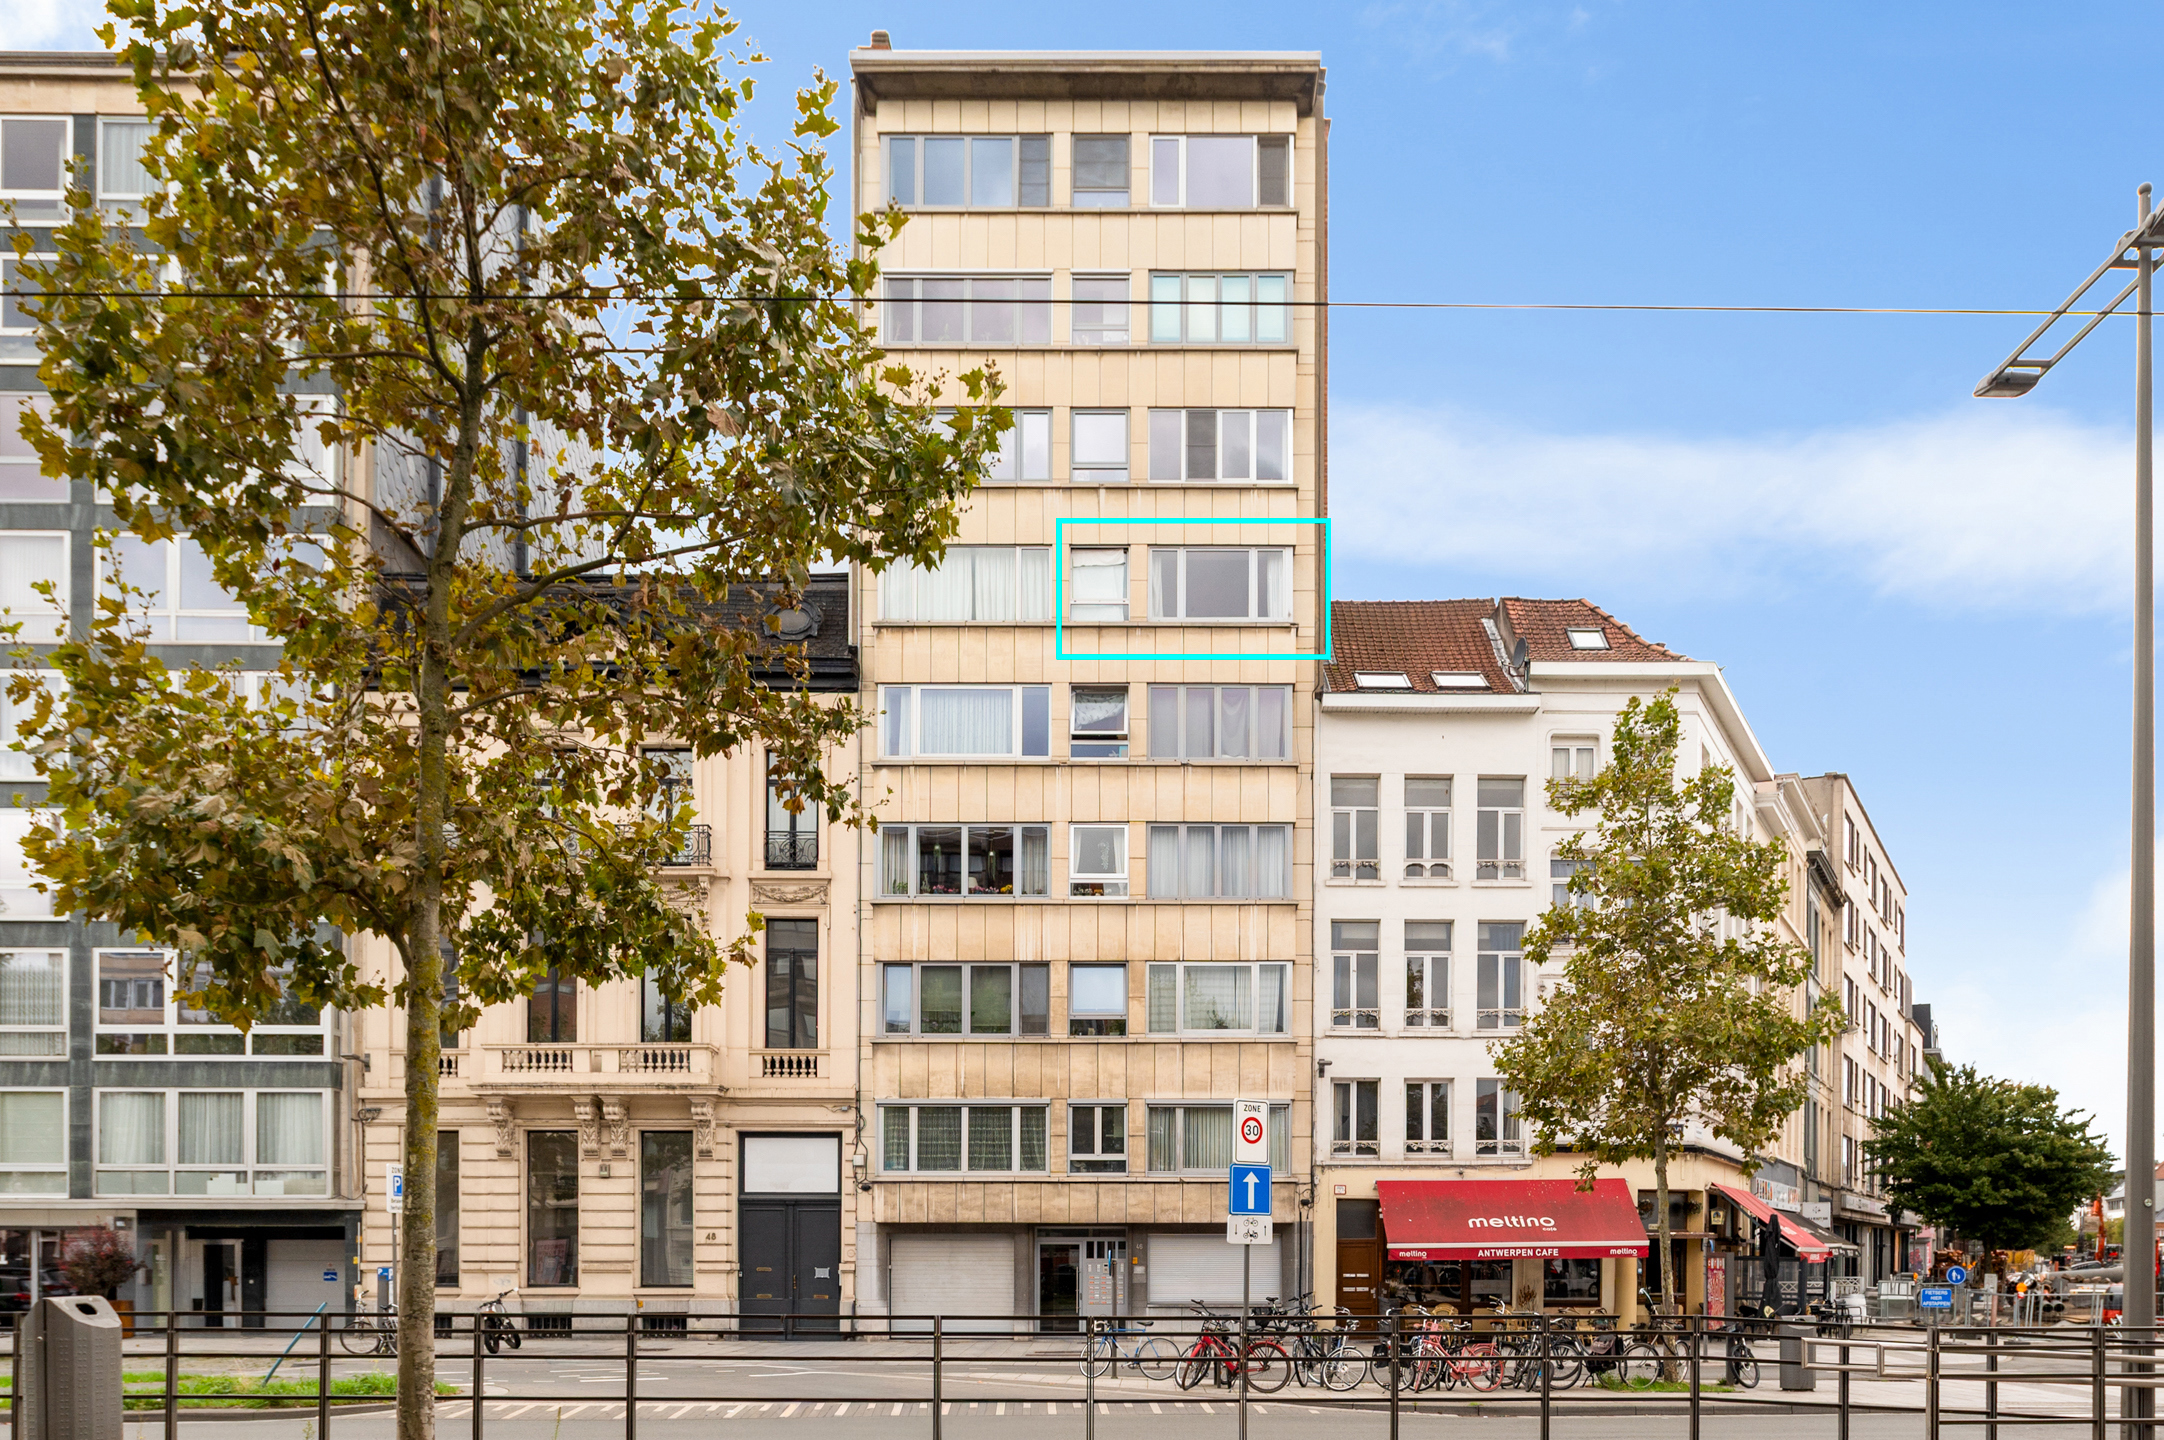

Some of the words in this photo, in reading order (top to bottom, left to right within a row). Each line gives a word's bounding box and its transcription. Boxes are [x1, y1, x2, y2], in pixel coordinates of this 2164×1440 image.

[1243, 1104, 1262, 1113] ZONE
[1245, 1125, 1259, 1136] 30
[1468, 1215, 1555, 1228] meltino
[706, 1232, 716, 1240] 48
[1398, 1249, 1428, 1258] meltino
[1477, 1248, 1534, 1257] ANTWERPEN
[1535, 1247, 1559, 1257] CAFE
